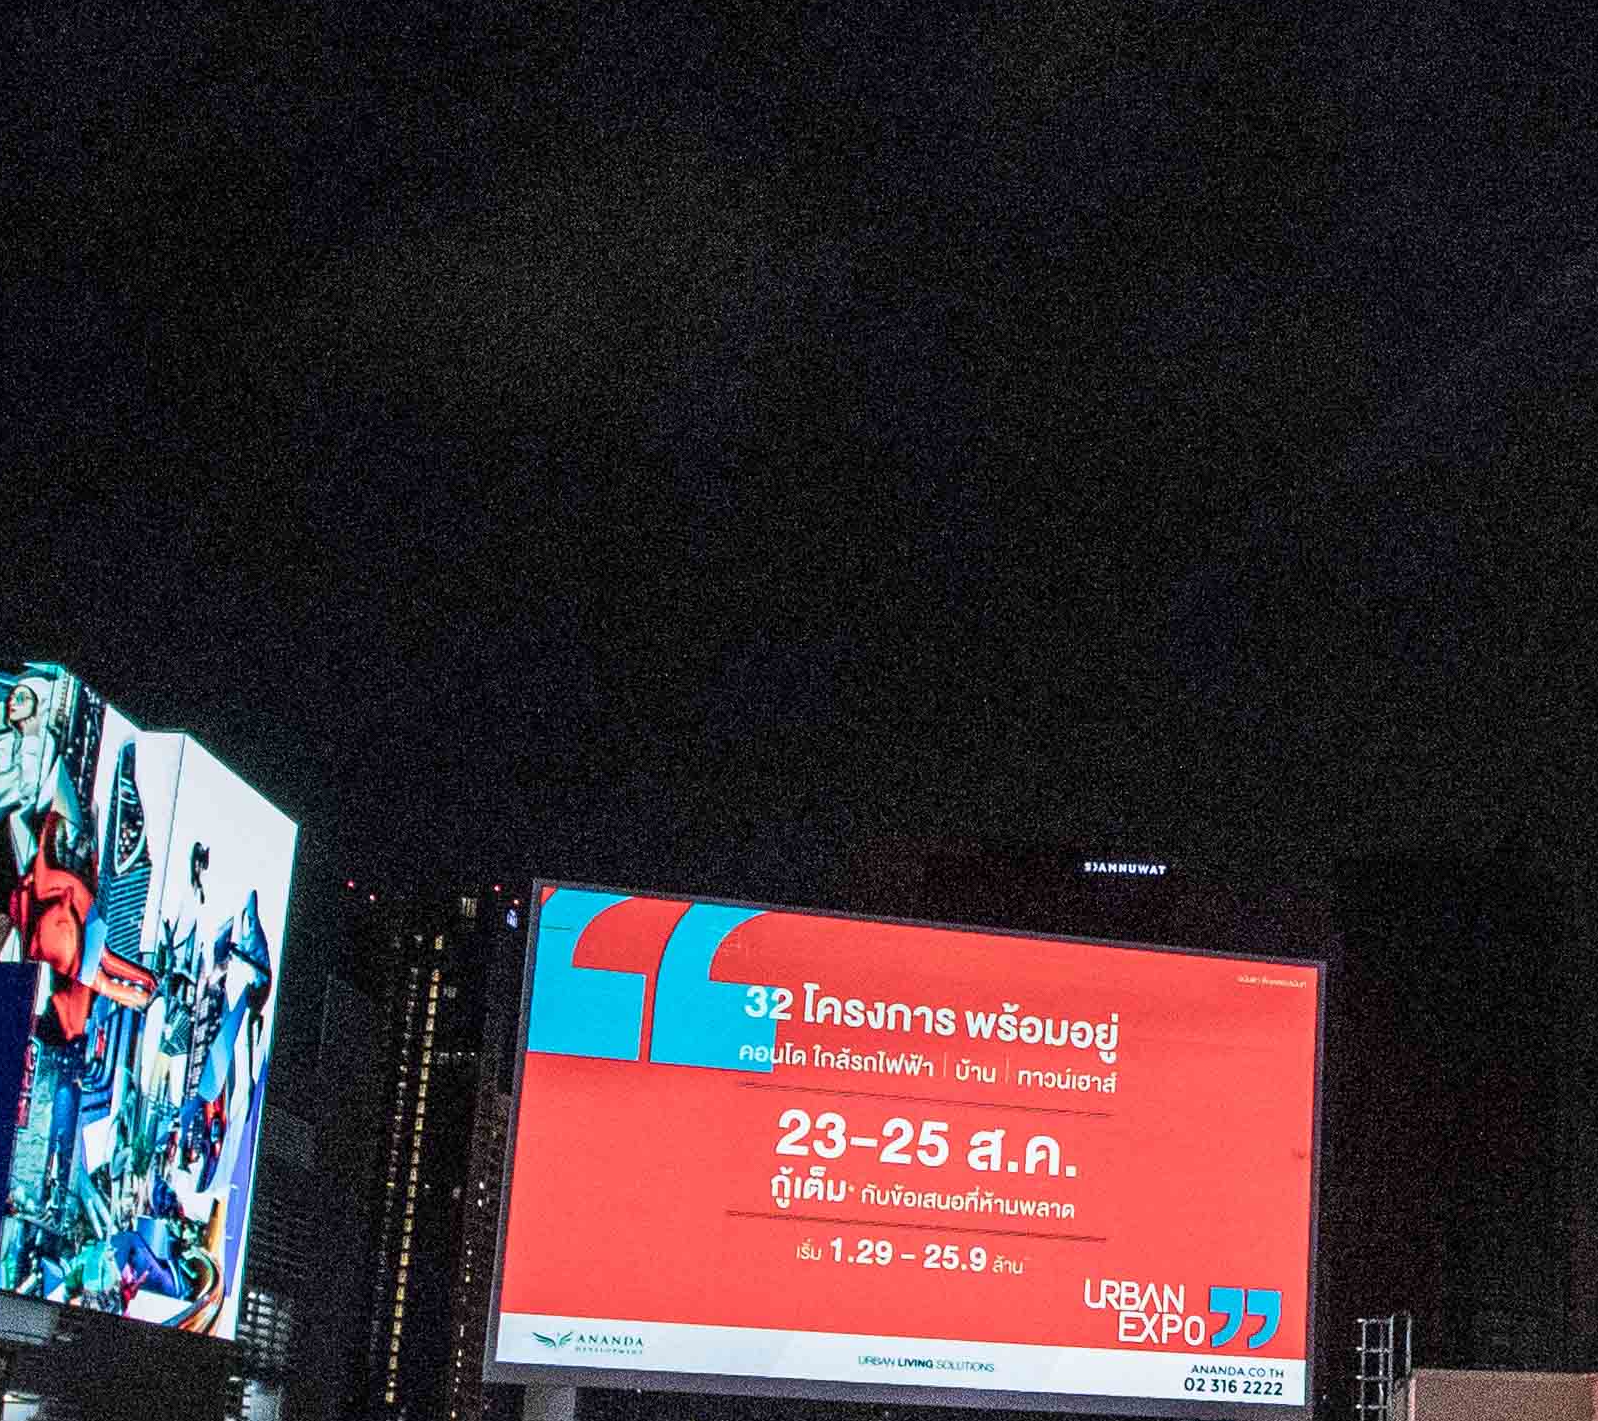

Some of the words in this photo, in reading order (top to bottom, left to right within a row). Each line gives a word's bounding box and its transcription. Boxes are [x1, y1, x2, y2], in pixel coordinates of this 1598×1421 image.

[744, 985, 794, 1021] 32
[802, 981, 957, 1037] โครงการ
[965, 1002, 1120, 1065] พร้อมอยู่
[738, 1043, 807, 1068] คอนโด
[813, 1043, 935, 1079] ใกล้รถไฟฟ้า
[955, 1057, 997, 1085] บ้าน
[967, 1128, 1079, 1179] ส.ค.
[829, 1236, 894, 1266] 1.29
[922, 1243, 988, 1273] 25.9
[1083, 1278, 1186, 1314] URBAN
[1117, 1311, 1206, 1347] EXPO
[897, 1357, 934, 1370] LIVING
[1183, 1377, 1206, 1393] 02
[1210, 1379, 1238, 1394] 316
[1242, 1380, 1284, 1397] 2222
